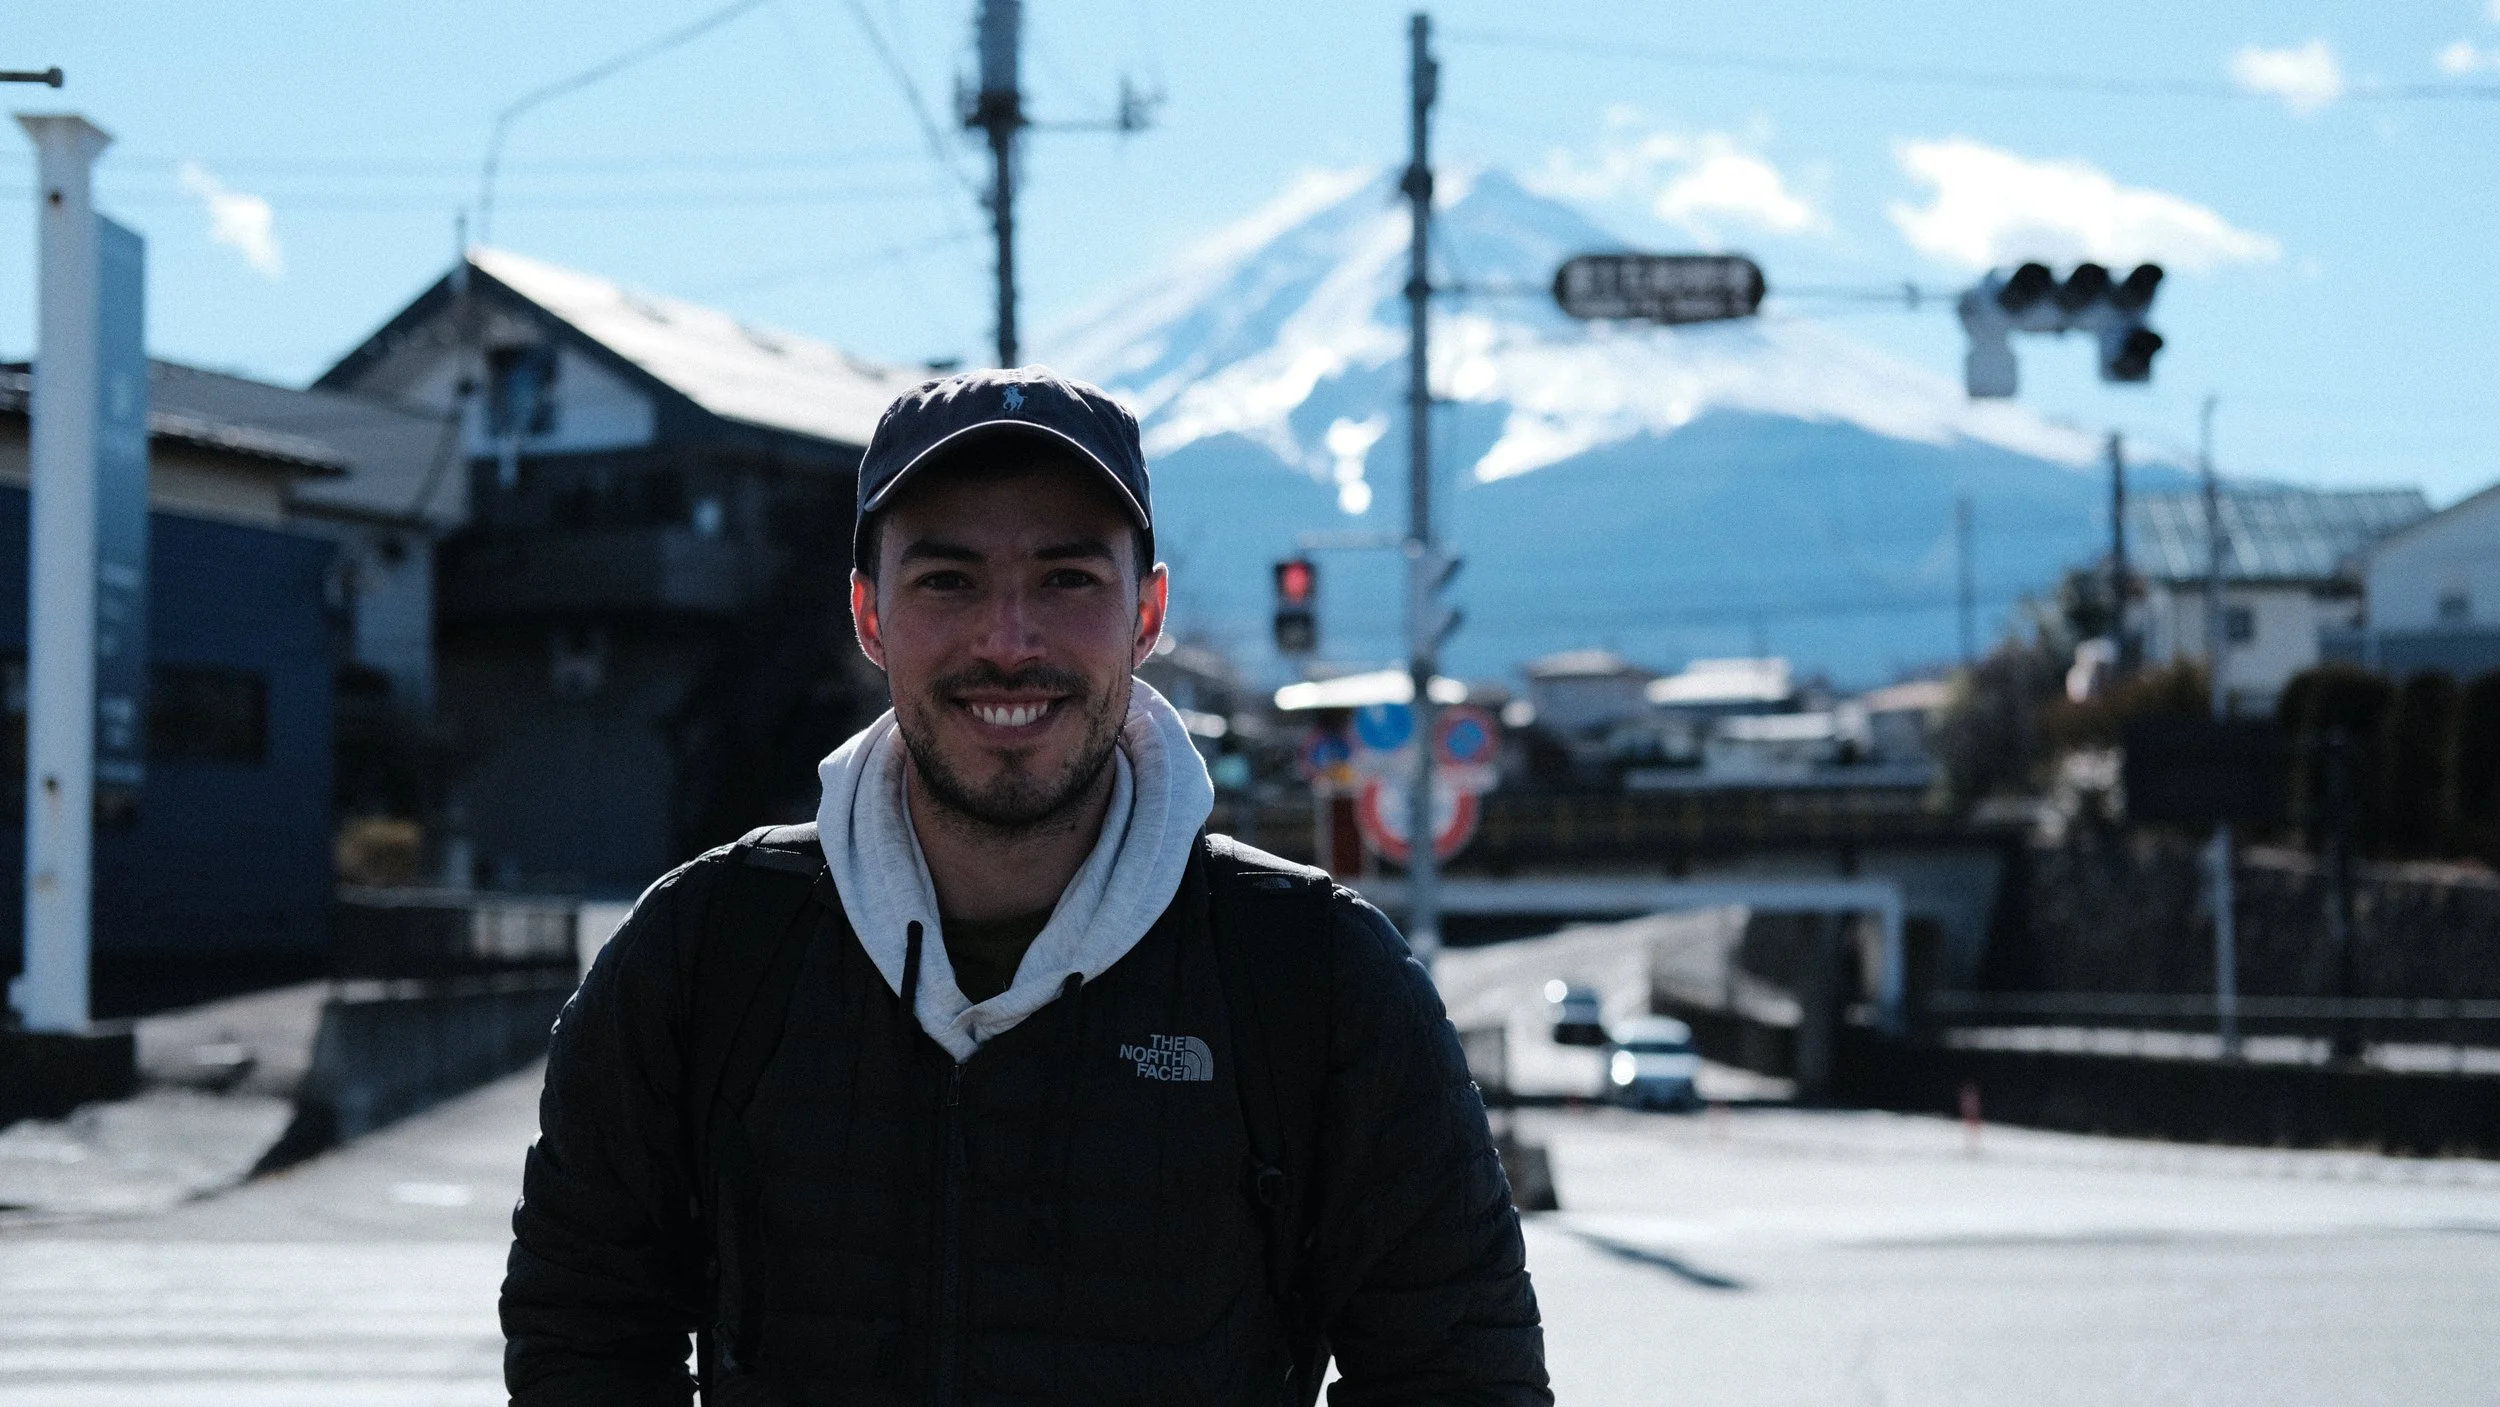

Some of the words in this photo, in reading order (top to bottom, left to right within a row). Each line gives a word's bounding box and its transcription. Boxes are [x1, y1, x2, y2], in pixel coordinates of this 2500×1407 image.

[1150, 1034, 1185, 1051] THE
[1120, 1044, 1185, 1066] NORTH
[1137, 1063, 1183, 1081] FACE
